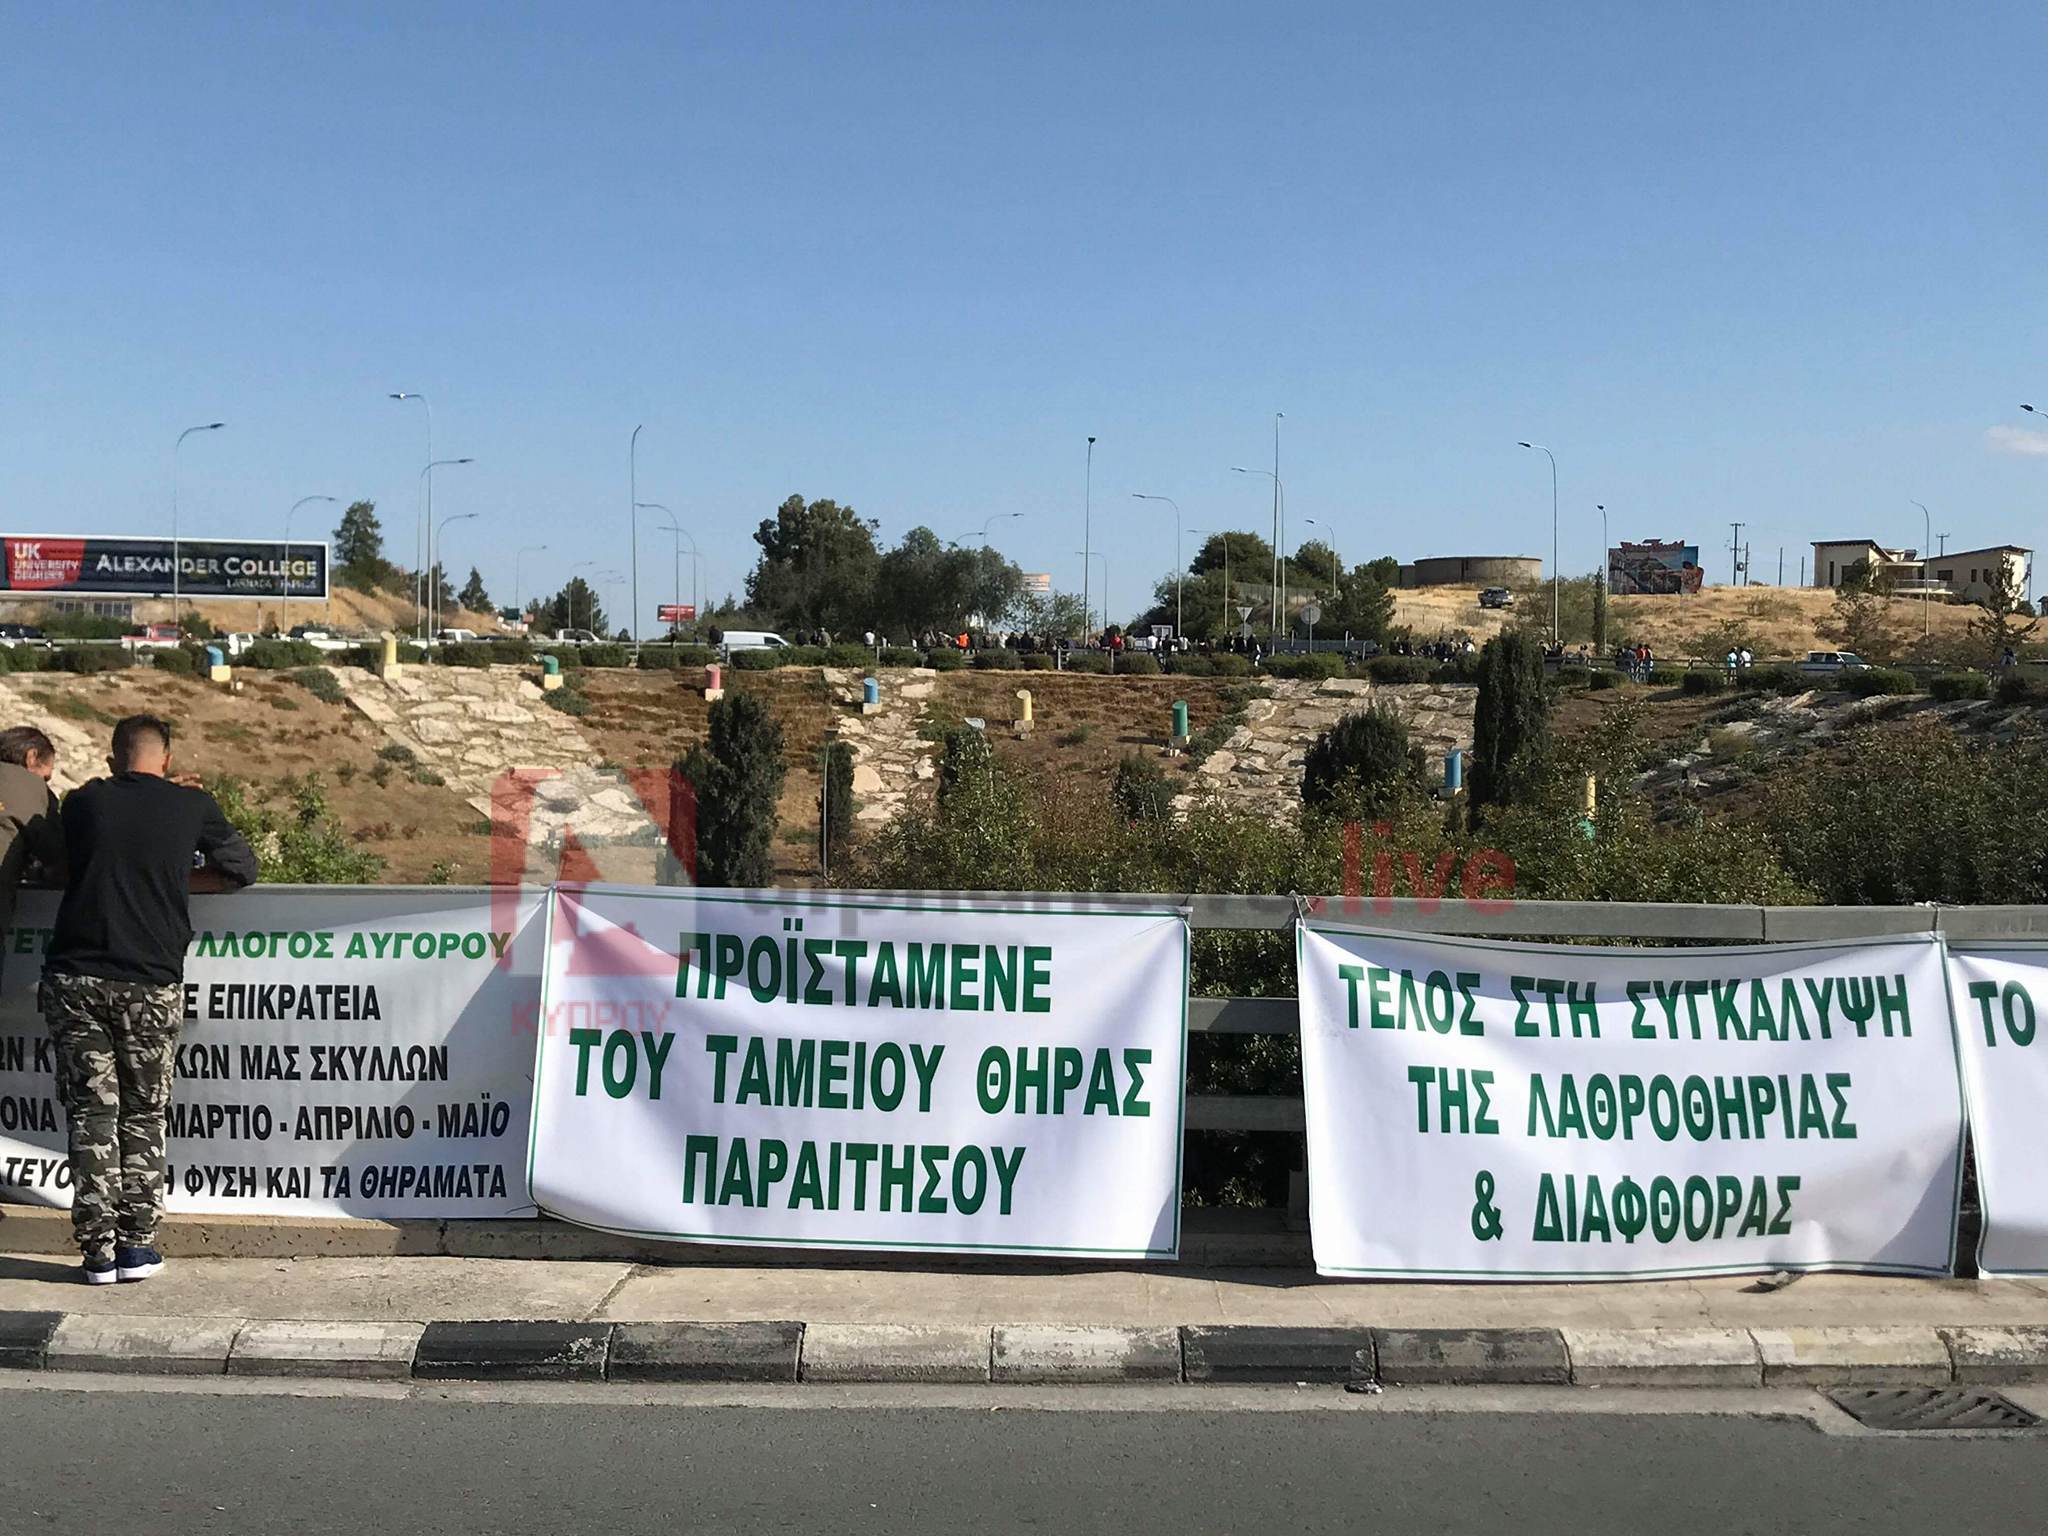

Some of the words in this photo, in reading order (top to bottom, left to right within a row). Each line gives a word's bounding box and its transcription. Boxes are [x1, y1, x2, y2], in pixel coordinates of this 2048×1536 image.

[14, 543, 41, 559] UK
[96, 554, 220, 574] ALEXANDER
[224, 557, 317, 576] COLLEGE
[194, 931, 334, 958] ΛΛΟΓΟΣ
[345, 932, 510, 960] ΑΥΓΟΡΟΥ
[675, 918, 1051, 1012] ΠΡΟΪΣΤΑΜΕΝΕ
[209, 984, 381, 1020] ΕΠΙΚΡΑΤΕΙΑ
[1339, 964, 1484, 1036] ΤΕΛΟΣ
[1510, 976, 1601, 1038] ΣΤΗ
[1629, 974, 1911, 1041] ΣΥΓΚΑΛΥΨΗ
[1968, 980, 2035, 1047] ΤΟ
[240, 1045, 301, 1080] ΜΑΣ
[310, 1045, 448, 1081] ΣΚΥΛΛΩΝ
[568, 1028, 675, 1100] ΤΟΥ
[706, 1035, 945, 1112] ΤΑΜΕΙΟΥ
[977, 1046, 1151, 1117] ΘΗΡΑΣ
[166, 1104, 272, 1140] ΜΑΡΤΙΟ
[294, 1105, 414, 1140] ΑΠΡΙΛΙΟ
[438, 1093, 510, 1138] ΜΑΪΟ
[1408, 1066, 1499, 1134] ΤΗΣ
[1527, 1073, 1857, 1141] ΛΑΘΡΟΘΗΡΙΑΣ
[184, 1164, 256, 1197] ΦΥΣΗ
[266, 1167, 310, 1198] ΚΑΙ
[320, 1166, 351, 1198] ΤΑ
[360, 1165, 507, 1199] ΘΗΡΑΜΑΤΑ
[683, 1135, 1026, 1215] ΠΑΡΑΙΤΗΣΟΥ
[1472, 1171, 1503, 1242] &
[1533, 1173, 1801, 1243] ΔΙΑΦΘΟΡΑΣ
